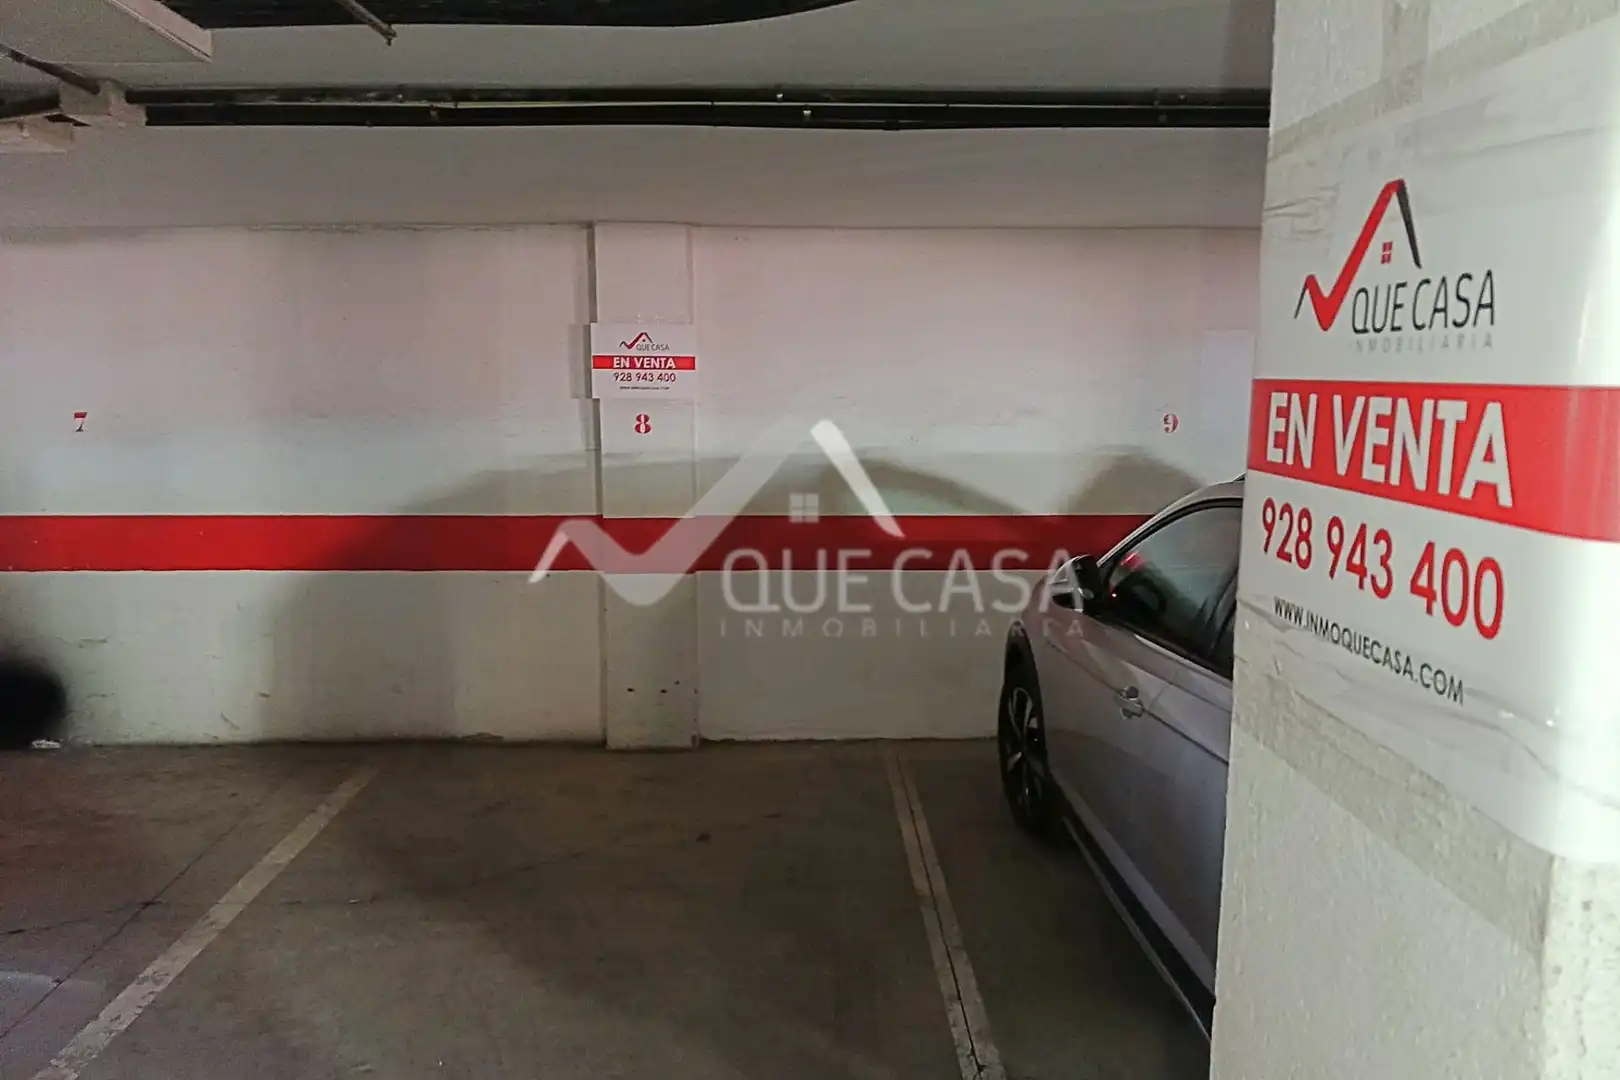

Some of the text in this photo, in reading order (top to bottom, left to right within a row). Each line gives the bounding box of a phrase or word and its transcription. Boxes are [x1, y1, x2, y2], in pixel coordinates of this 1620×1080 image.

[1352, 269, 1495, 334] QUE CASA
[613, 357, 676, 369] EN VENTA
[613, 372, 677, 382] 928 943 400
[73, 411, 88, 433] 7
[634, 413, 652, 434] 8
[1163, 413, 1179, 434] 9
[1266, 391, 1513, 508] EN VENTA
[1262, 496, 1505, 640] 928 943 400
[1273, 596, 1464, 705] WWW.INMOQUECASA.COM
